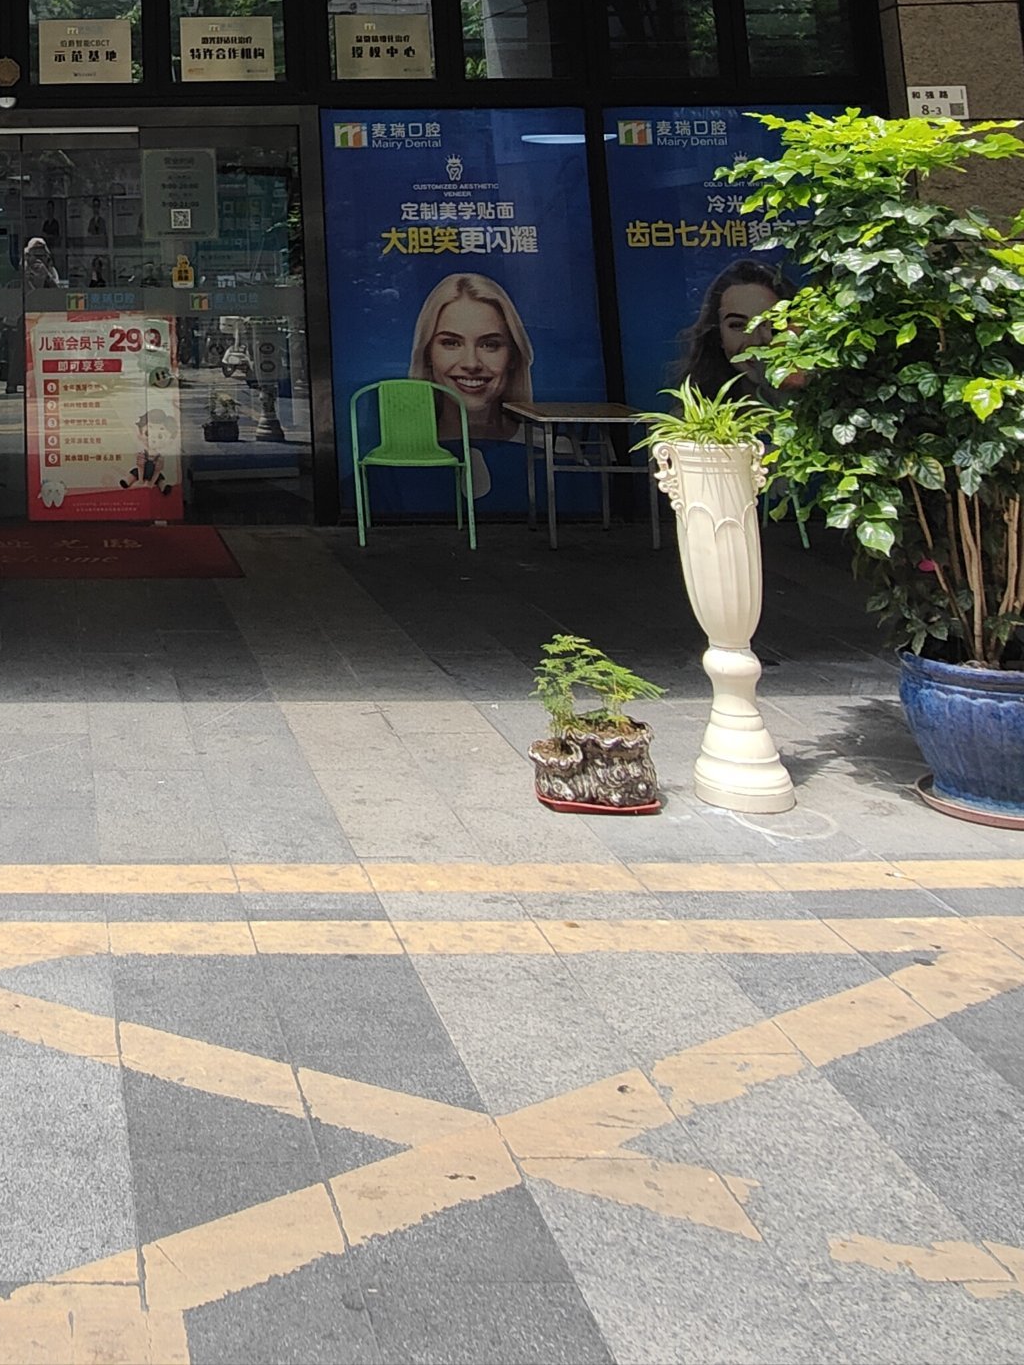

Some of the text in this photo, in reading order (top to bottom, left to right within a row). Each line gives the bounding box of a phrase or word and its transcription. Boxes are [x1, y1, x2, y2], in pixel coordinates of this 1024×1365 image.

[54, 50, 117, 62] 示范基地
[189, 47, 265, 60] 特许合作机构
[921, 104, 942, 115] 8-3
[371, 122, 441, 139] 麦瑞口腔
[656, 120, 727, 136] 麦瑞口腔
[372, 138, 442, 150] Mairy Dental
[656, 136, 728, 148] Mairy Dental
[401, 202, 515, 221] 定制美学贴面
[381, 226, 539, 255] 大胆笑更闪耀
[626, 220, 814, 248] 齿白七分俏貌
[38, 336, 105, 351] 儿童会员卡
[108, 328, 161, 352] 299
[57, 361, 105, 372] 即可享受
